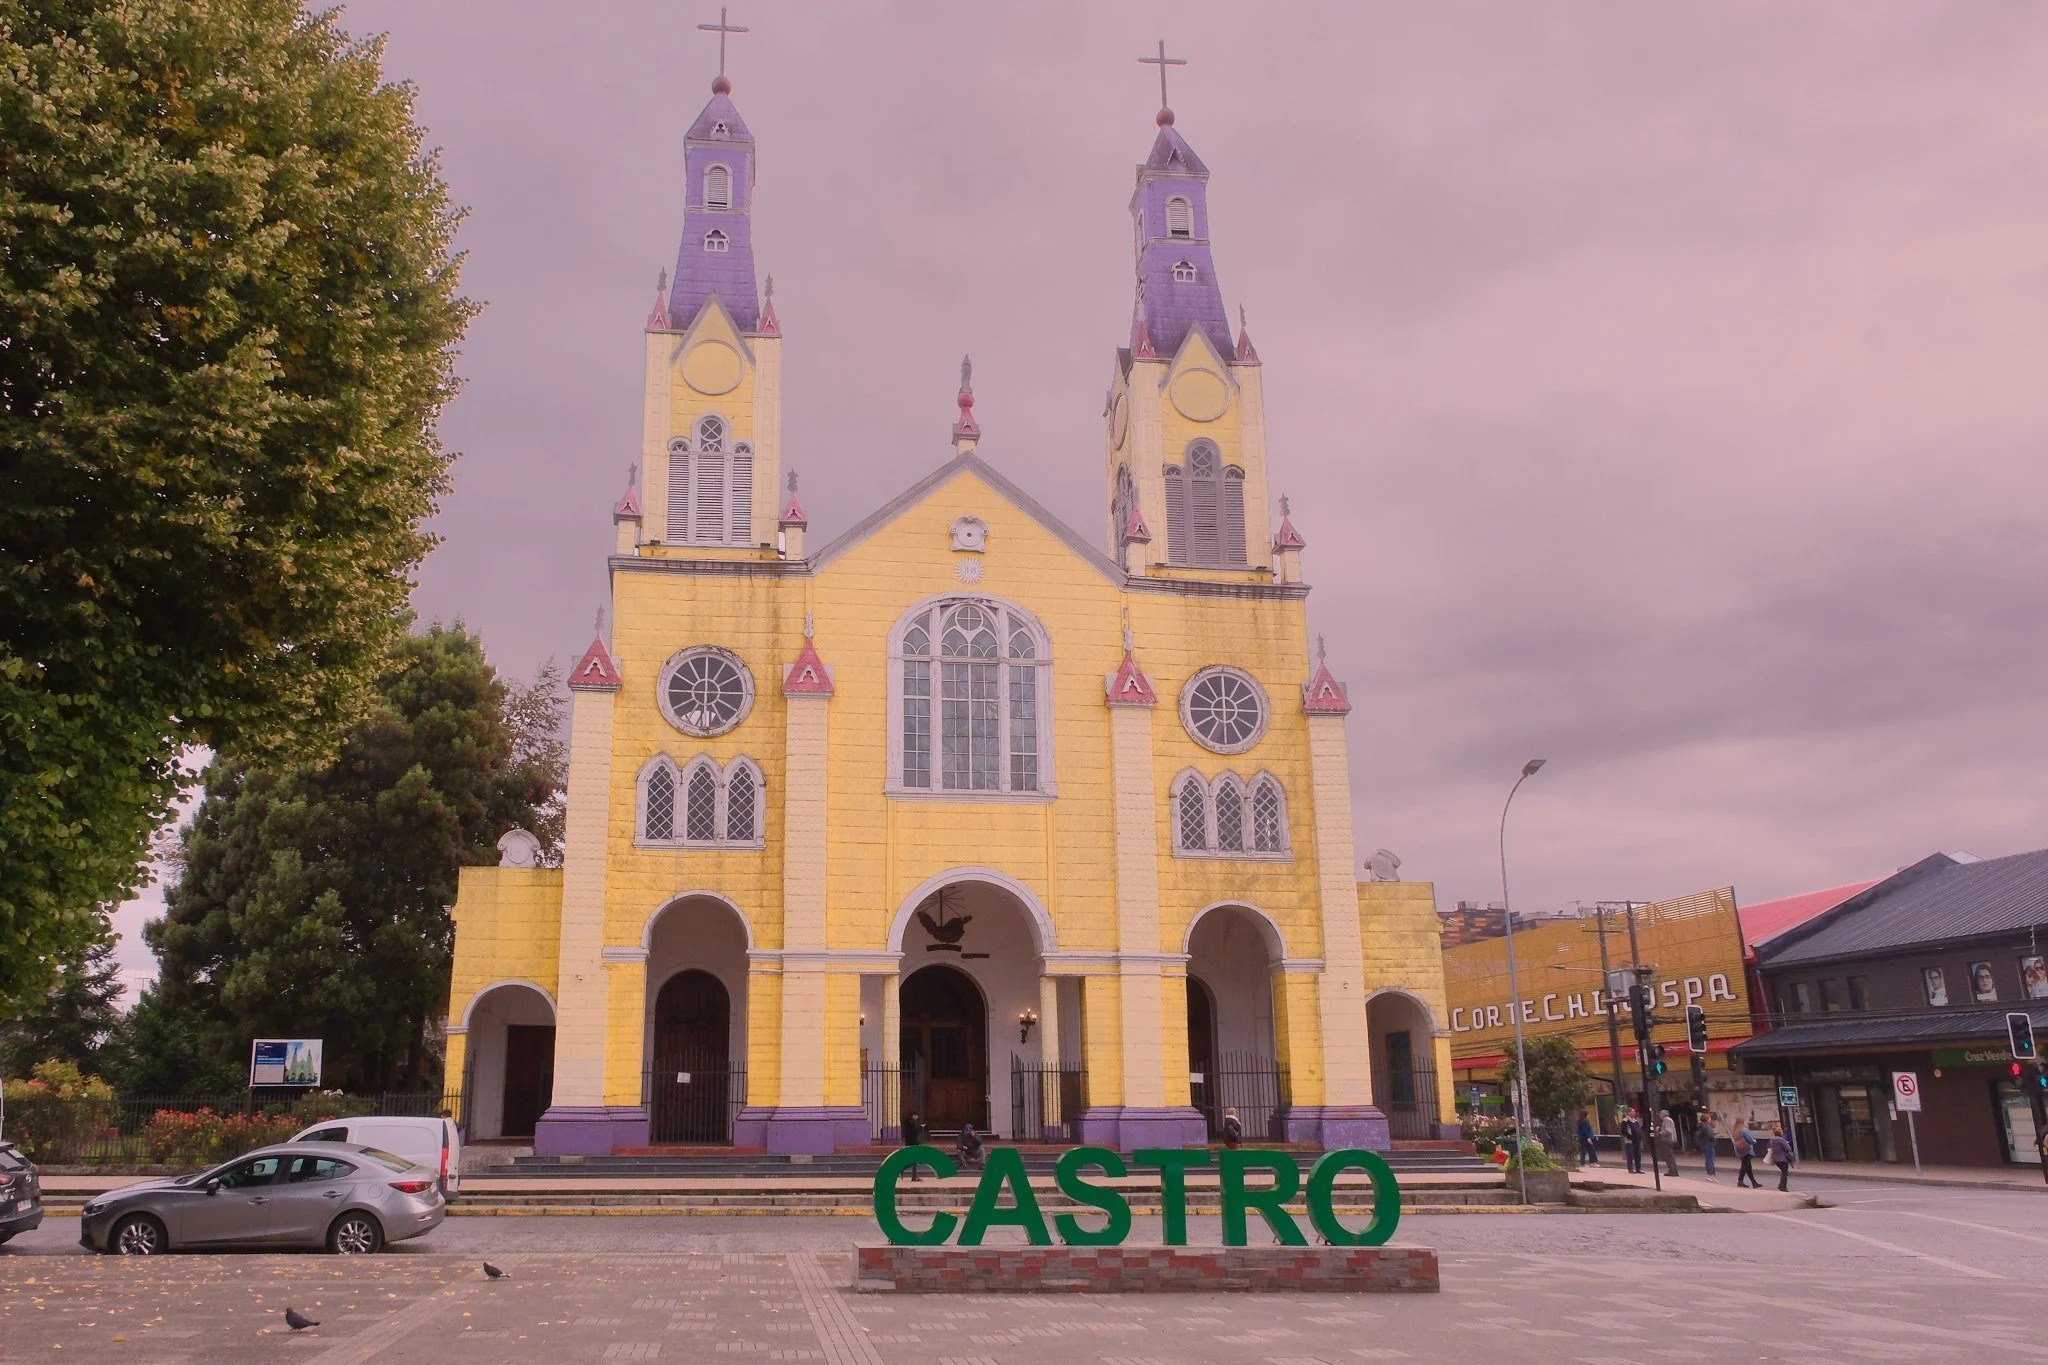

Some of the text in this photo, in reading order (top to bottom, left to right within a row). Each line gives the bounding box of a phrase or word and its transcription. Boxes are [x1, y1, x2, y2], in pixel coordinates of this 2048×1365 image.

[1964, 1050, 2012, 1062] Cruz Verde
[873, 1145, 1401, 1247] CASTRO
